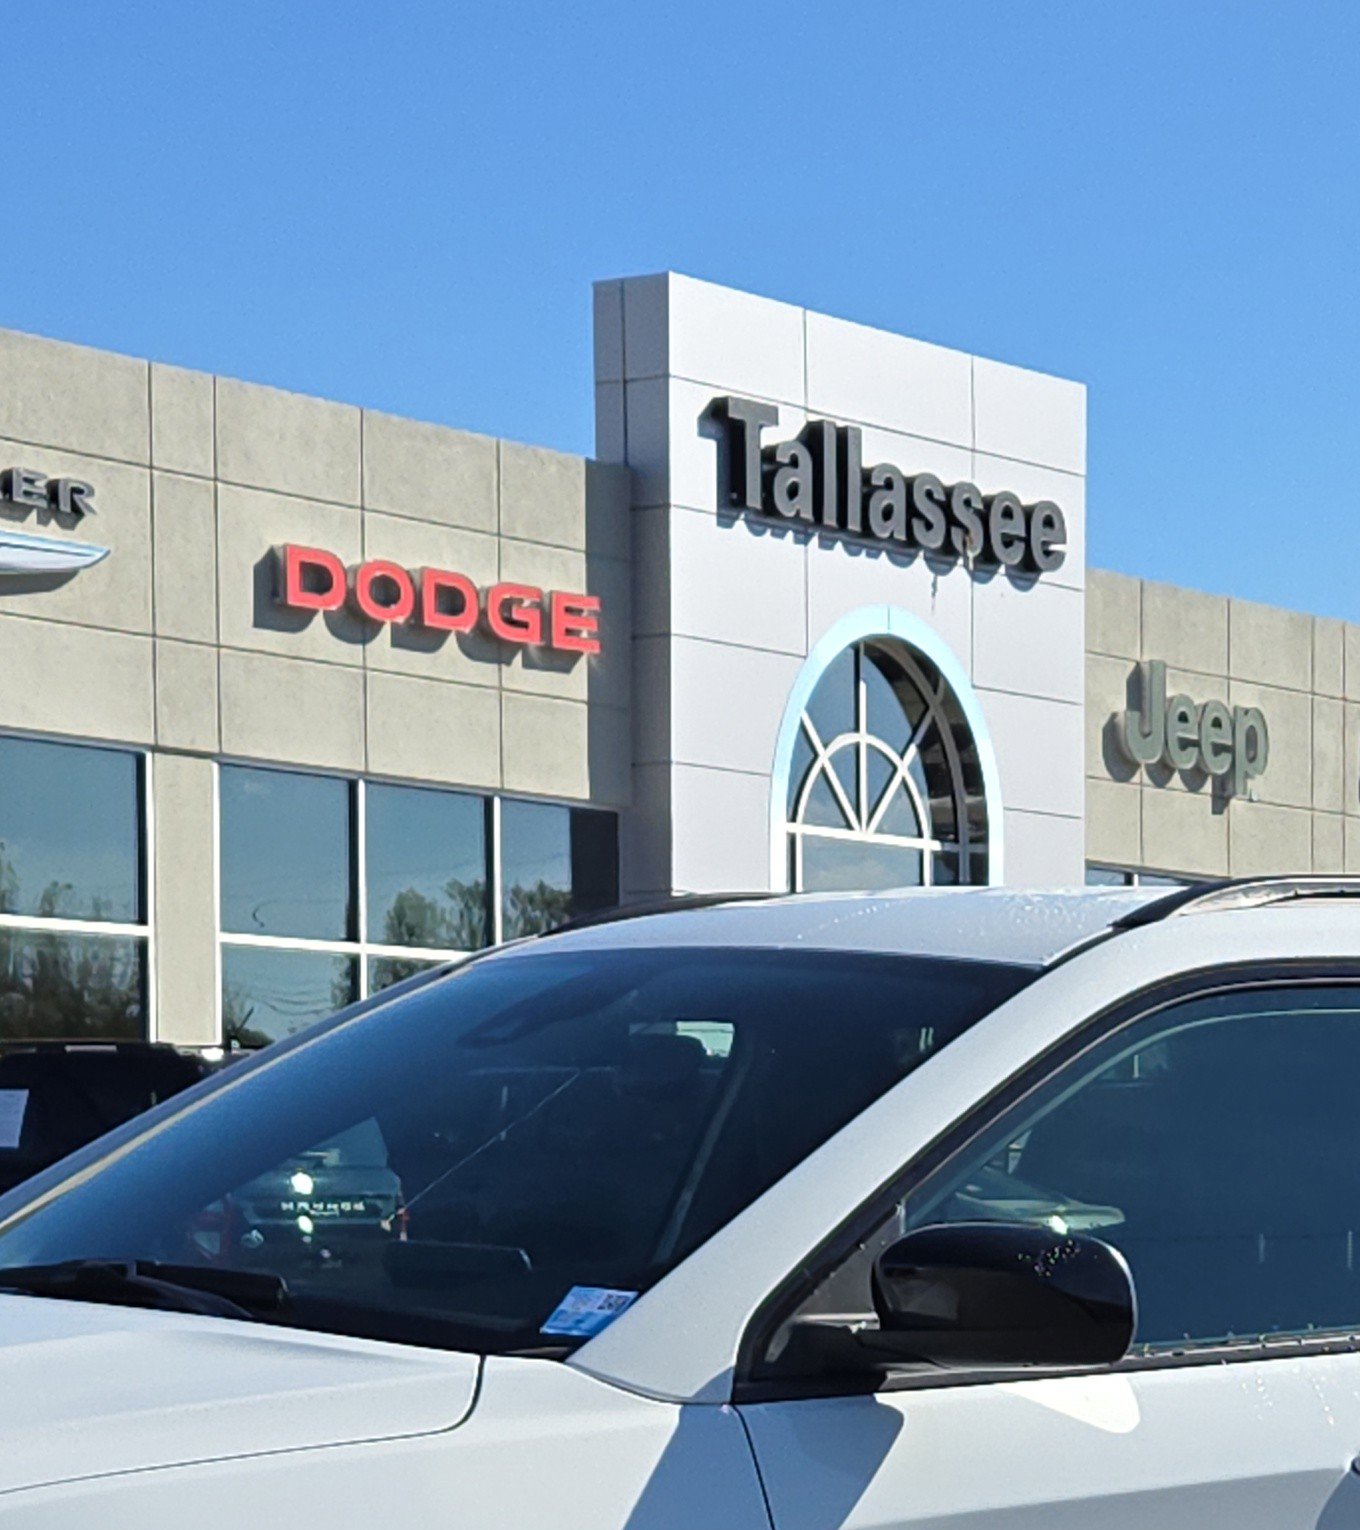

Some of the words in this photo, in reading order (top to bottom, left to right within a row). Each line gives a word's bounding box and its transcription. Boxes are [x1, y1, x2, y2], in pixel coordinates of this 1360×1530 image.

[728, 396, 1068, 573] Tallassee
[284, 543, 601, 654] DODGE
[1125, 659, 1269, 801] Jeep
